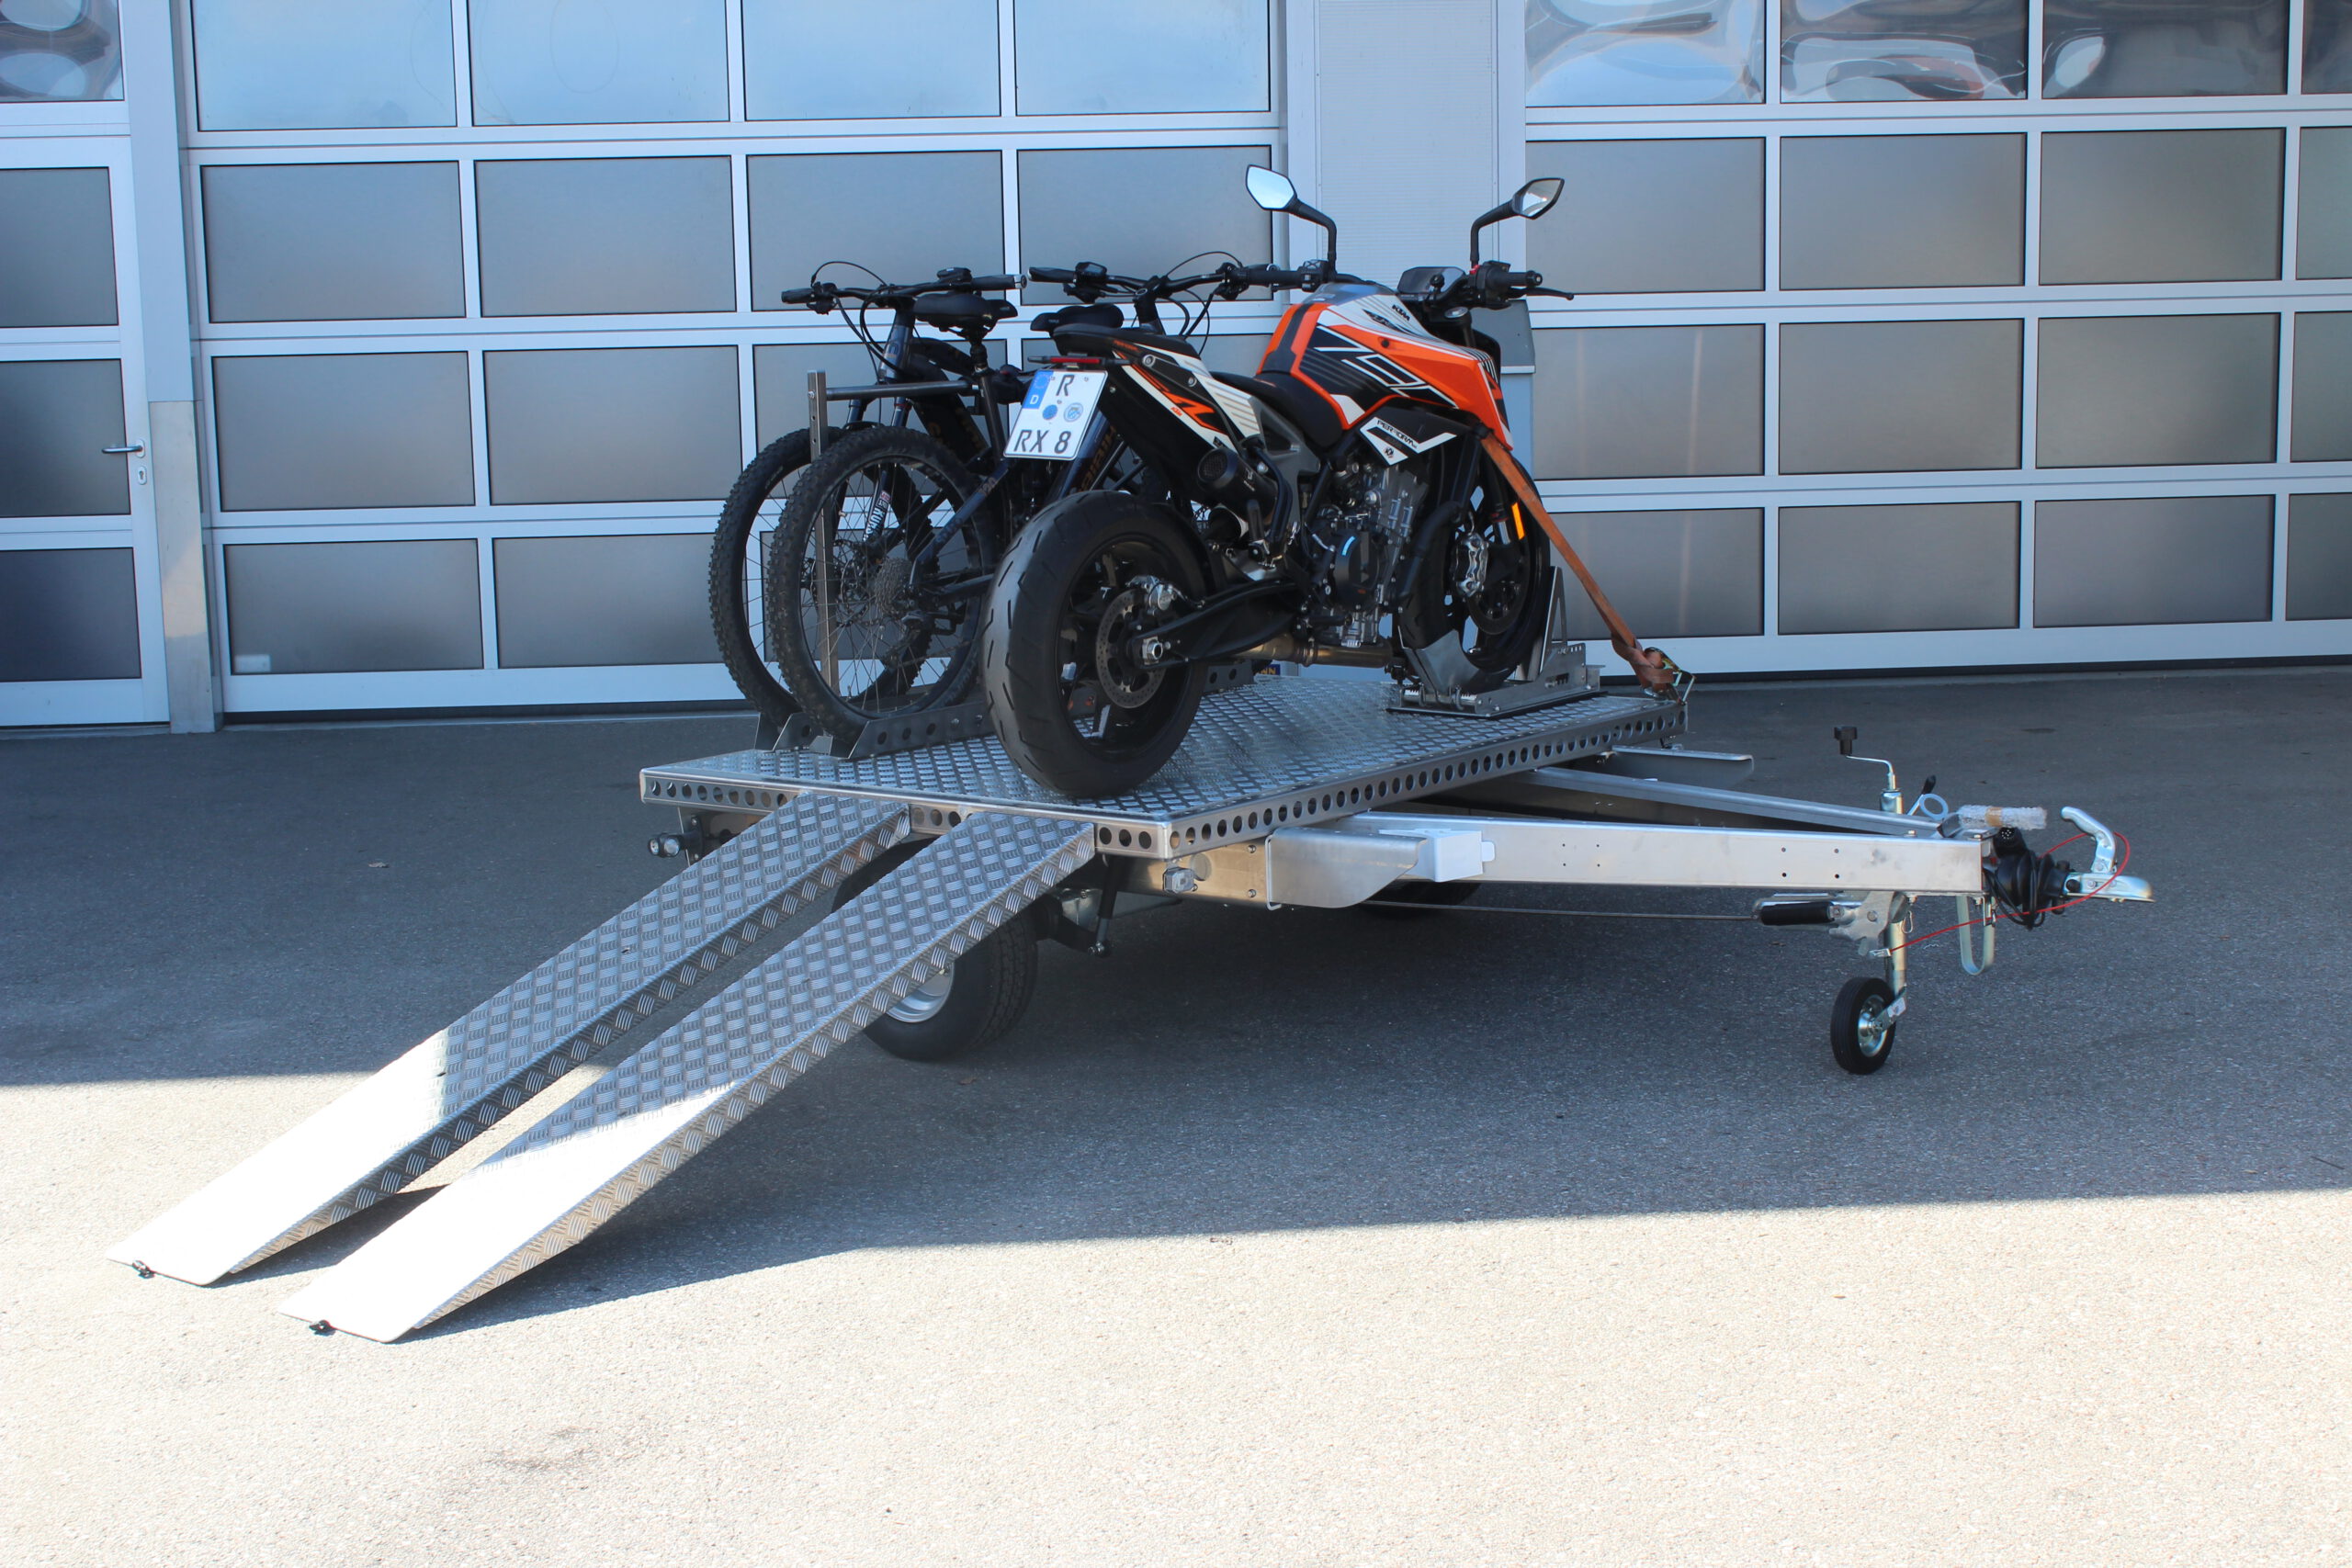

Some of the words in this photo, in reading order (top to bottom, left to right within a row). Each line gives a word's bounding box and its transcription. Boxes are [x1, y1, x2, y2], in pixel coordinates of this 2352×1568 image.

[1391, 304, 1410, 321] KTM
[1056, 374, 1075, 397] R
[1030, 395, 1039, 405] D
[1013, 429, 1049, 453] RX
[1054, 430, 1071, 454] 8
